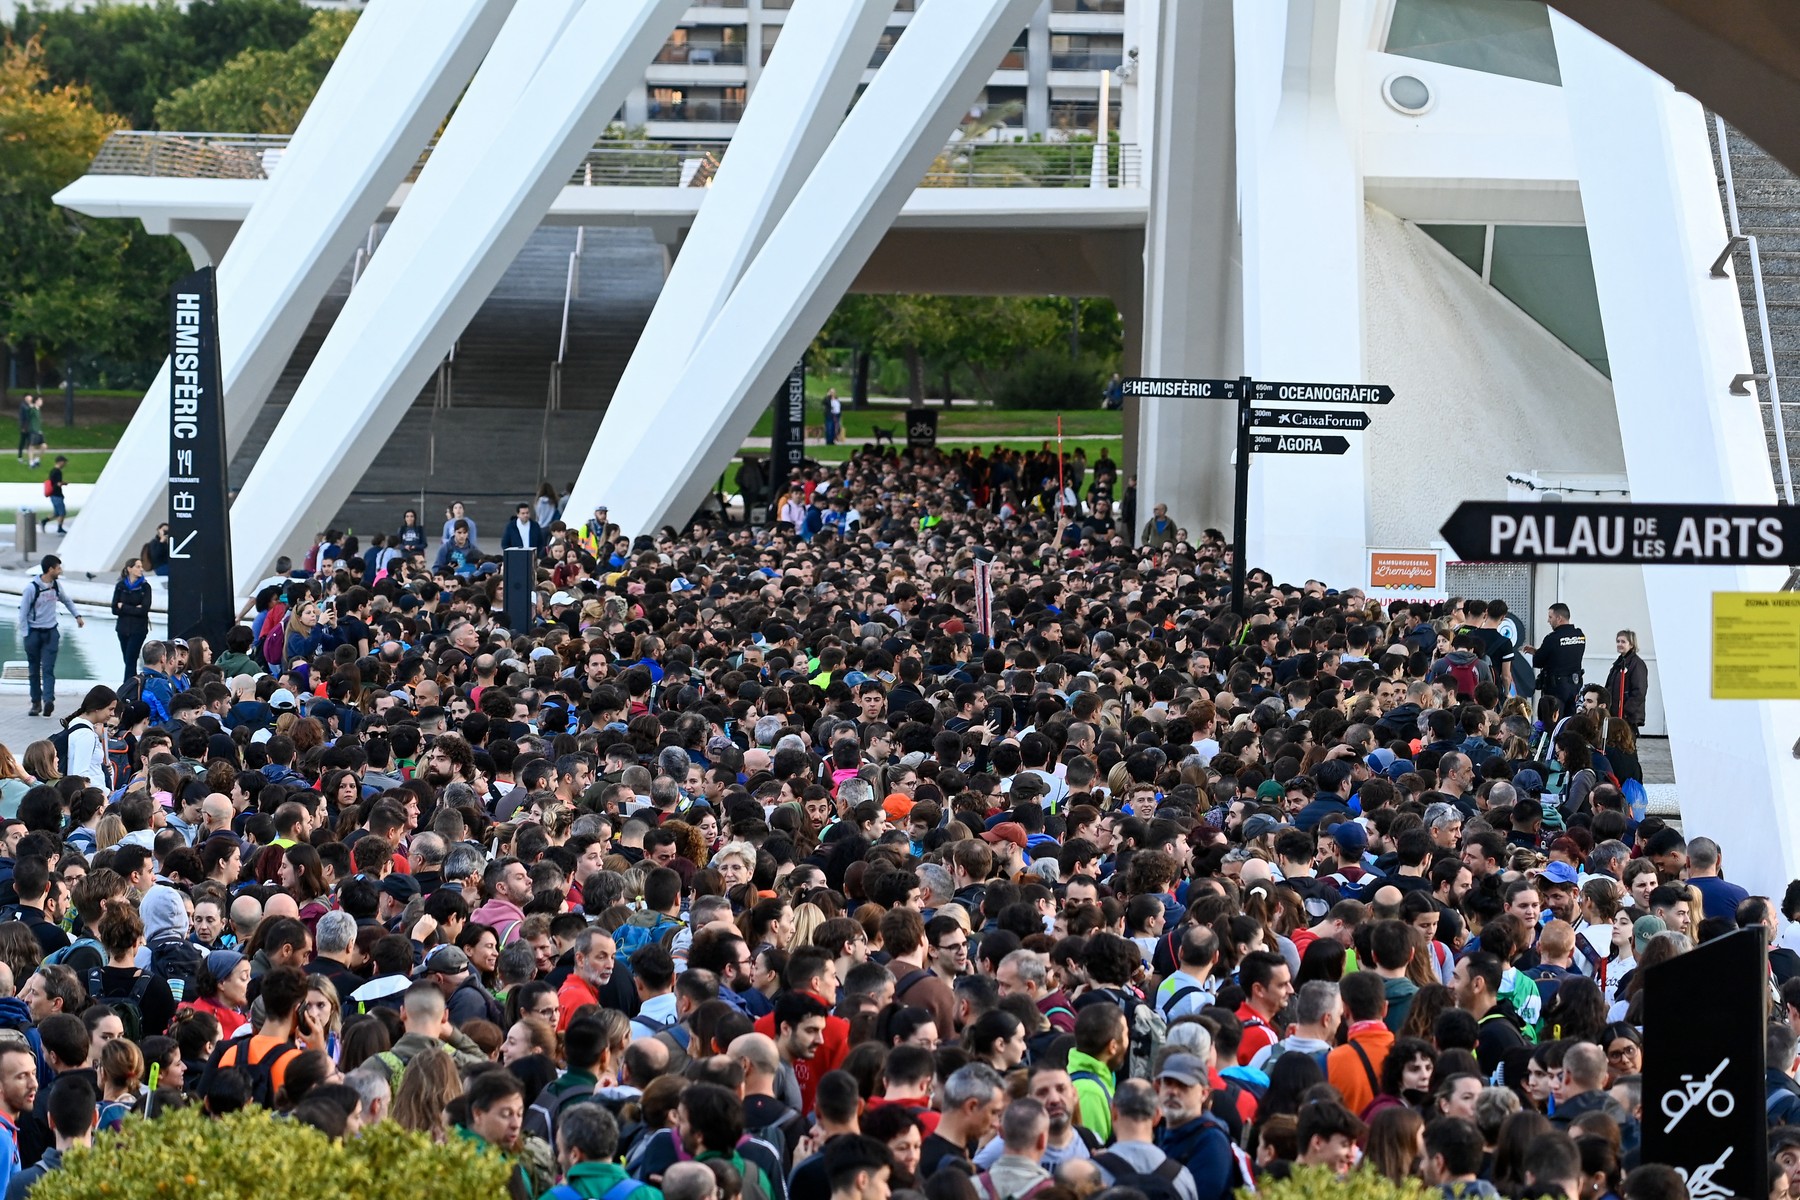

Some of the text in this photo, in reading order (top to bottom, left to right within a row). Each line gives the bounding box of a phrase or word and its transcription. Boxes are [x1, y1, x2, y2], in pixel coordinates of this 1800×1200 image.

[174, 293, 203, 438] HEMISFÈRIC
[1132, 380, 1212, 397] HEMISFÈRIC
[1278, 385, 1380, 402] OCEANOGRÀFIC
[789, 378, 802, 422] MUSEU
[1291, 413, 1363, 427] CaixaForum
[1277, 435, 1323, 452] ÀGORA
[1490, 515, 1784, 558] PALAU DE LES ARTS
